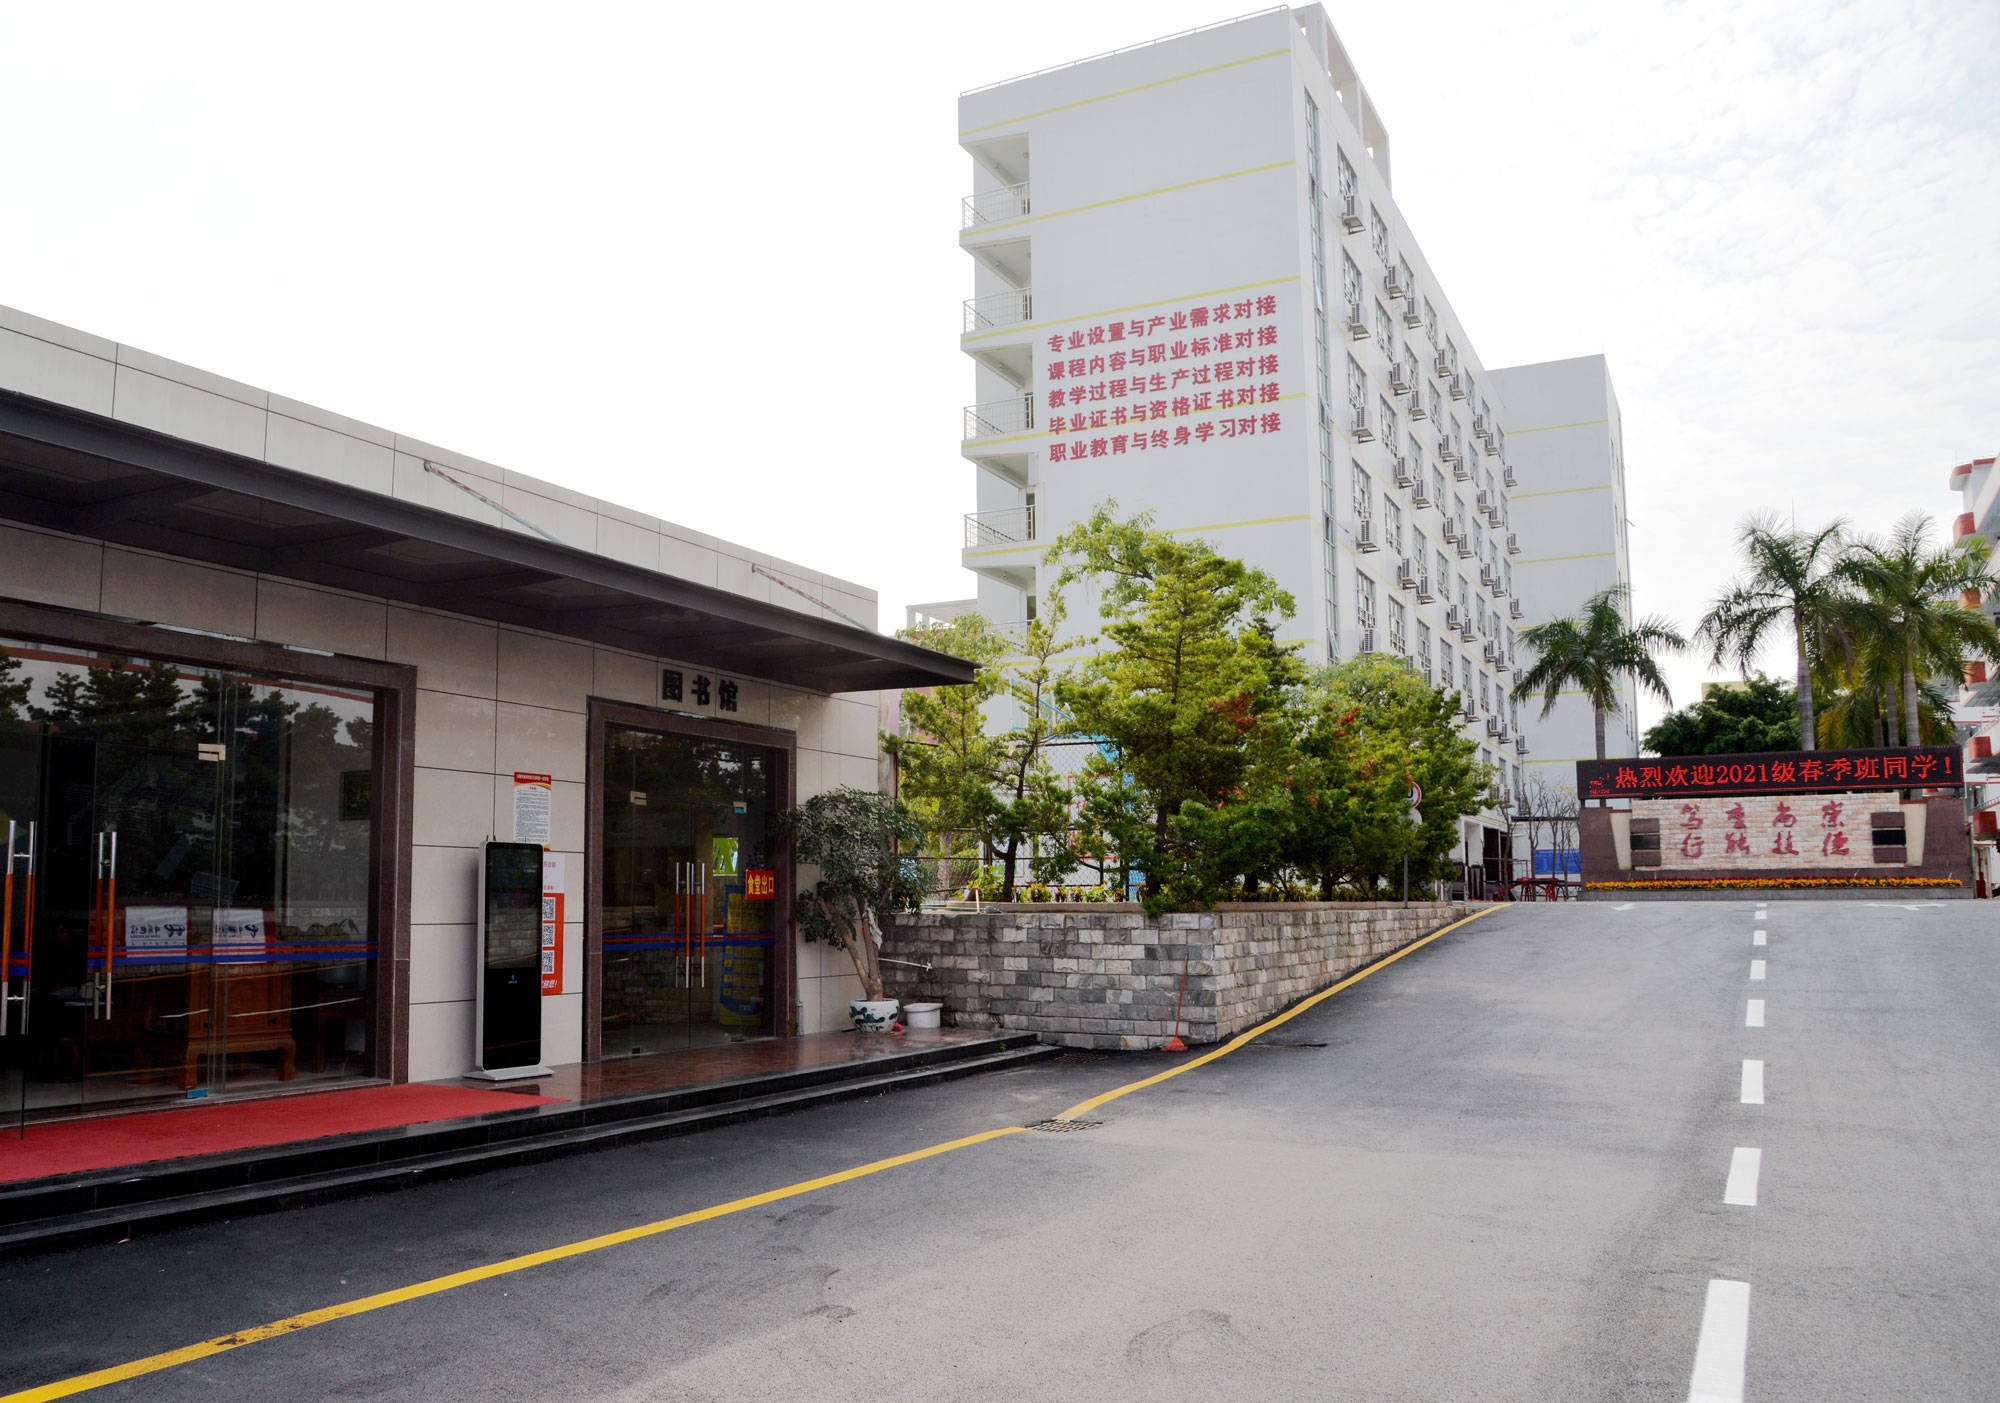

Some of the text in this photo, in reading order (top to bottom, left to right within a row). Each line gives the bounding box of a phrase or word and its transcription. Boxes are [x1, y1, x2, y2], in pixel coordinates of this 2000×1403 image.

[1048, 295, 1277, 353] 专业设置与产业需求对接
[1048, 325, 1279, 381] 课程内容与职业标准对接
[1048, 354, 1279, 409] 教学过程与生产过程对接
[1049, 382, 1280, 435] 毕业证书与资格证书对接
[1049, 412, 1281, 463] 职业教育与终身学习对接
[662, 669, 738, 712] 图书馆
[748, 874, 774, 895] 食堂出口
